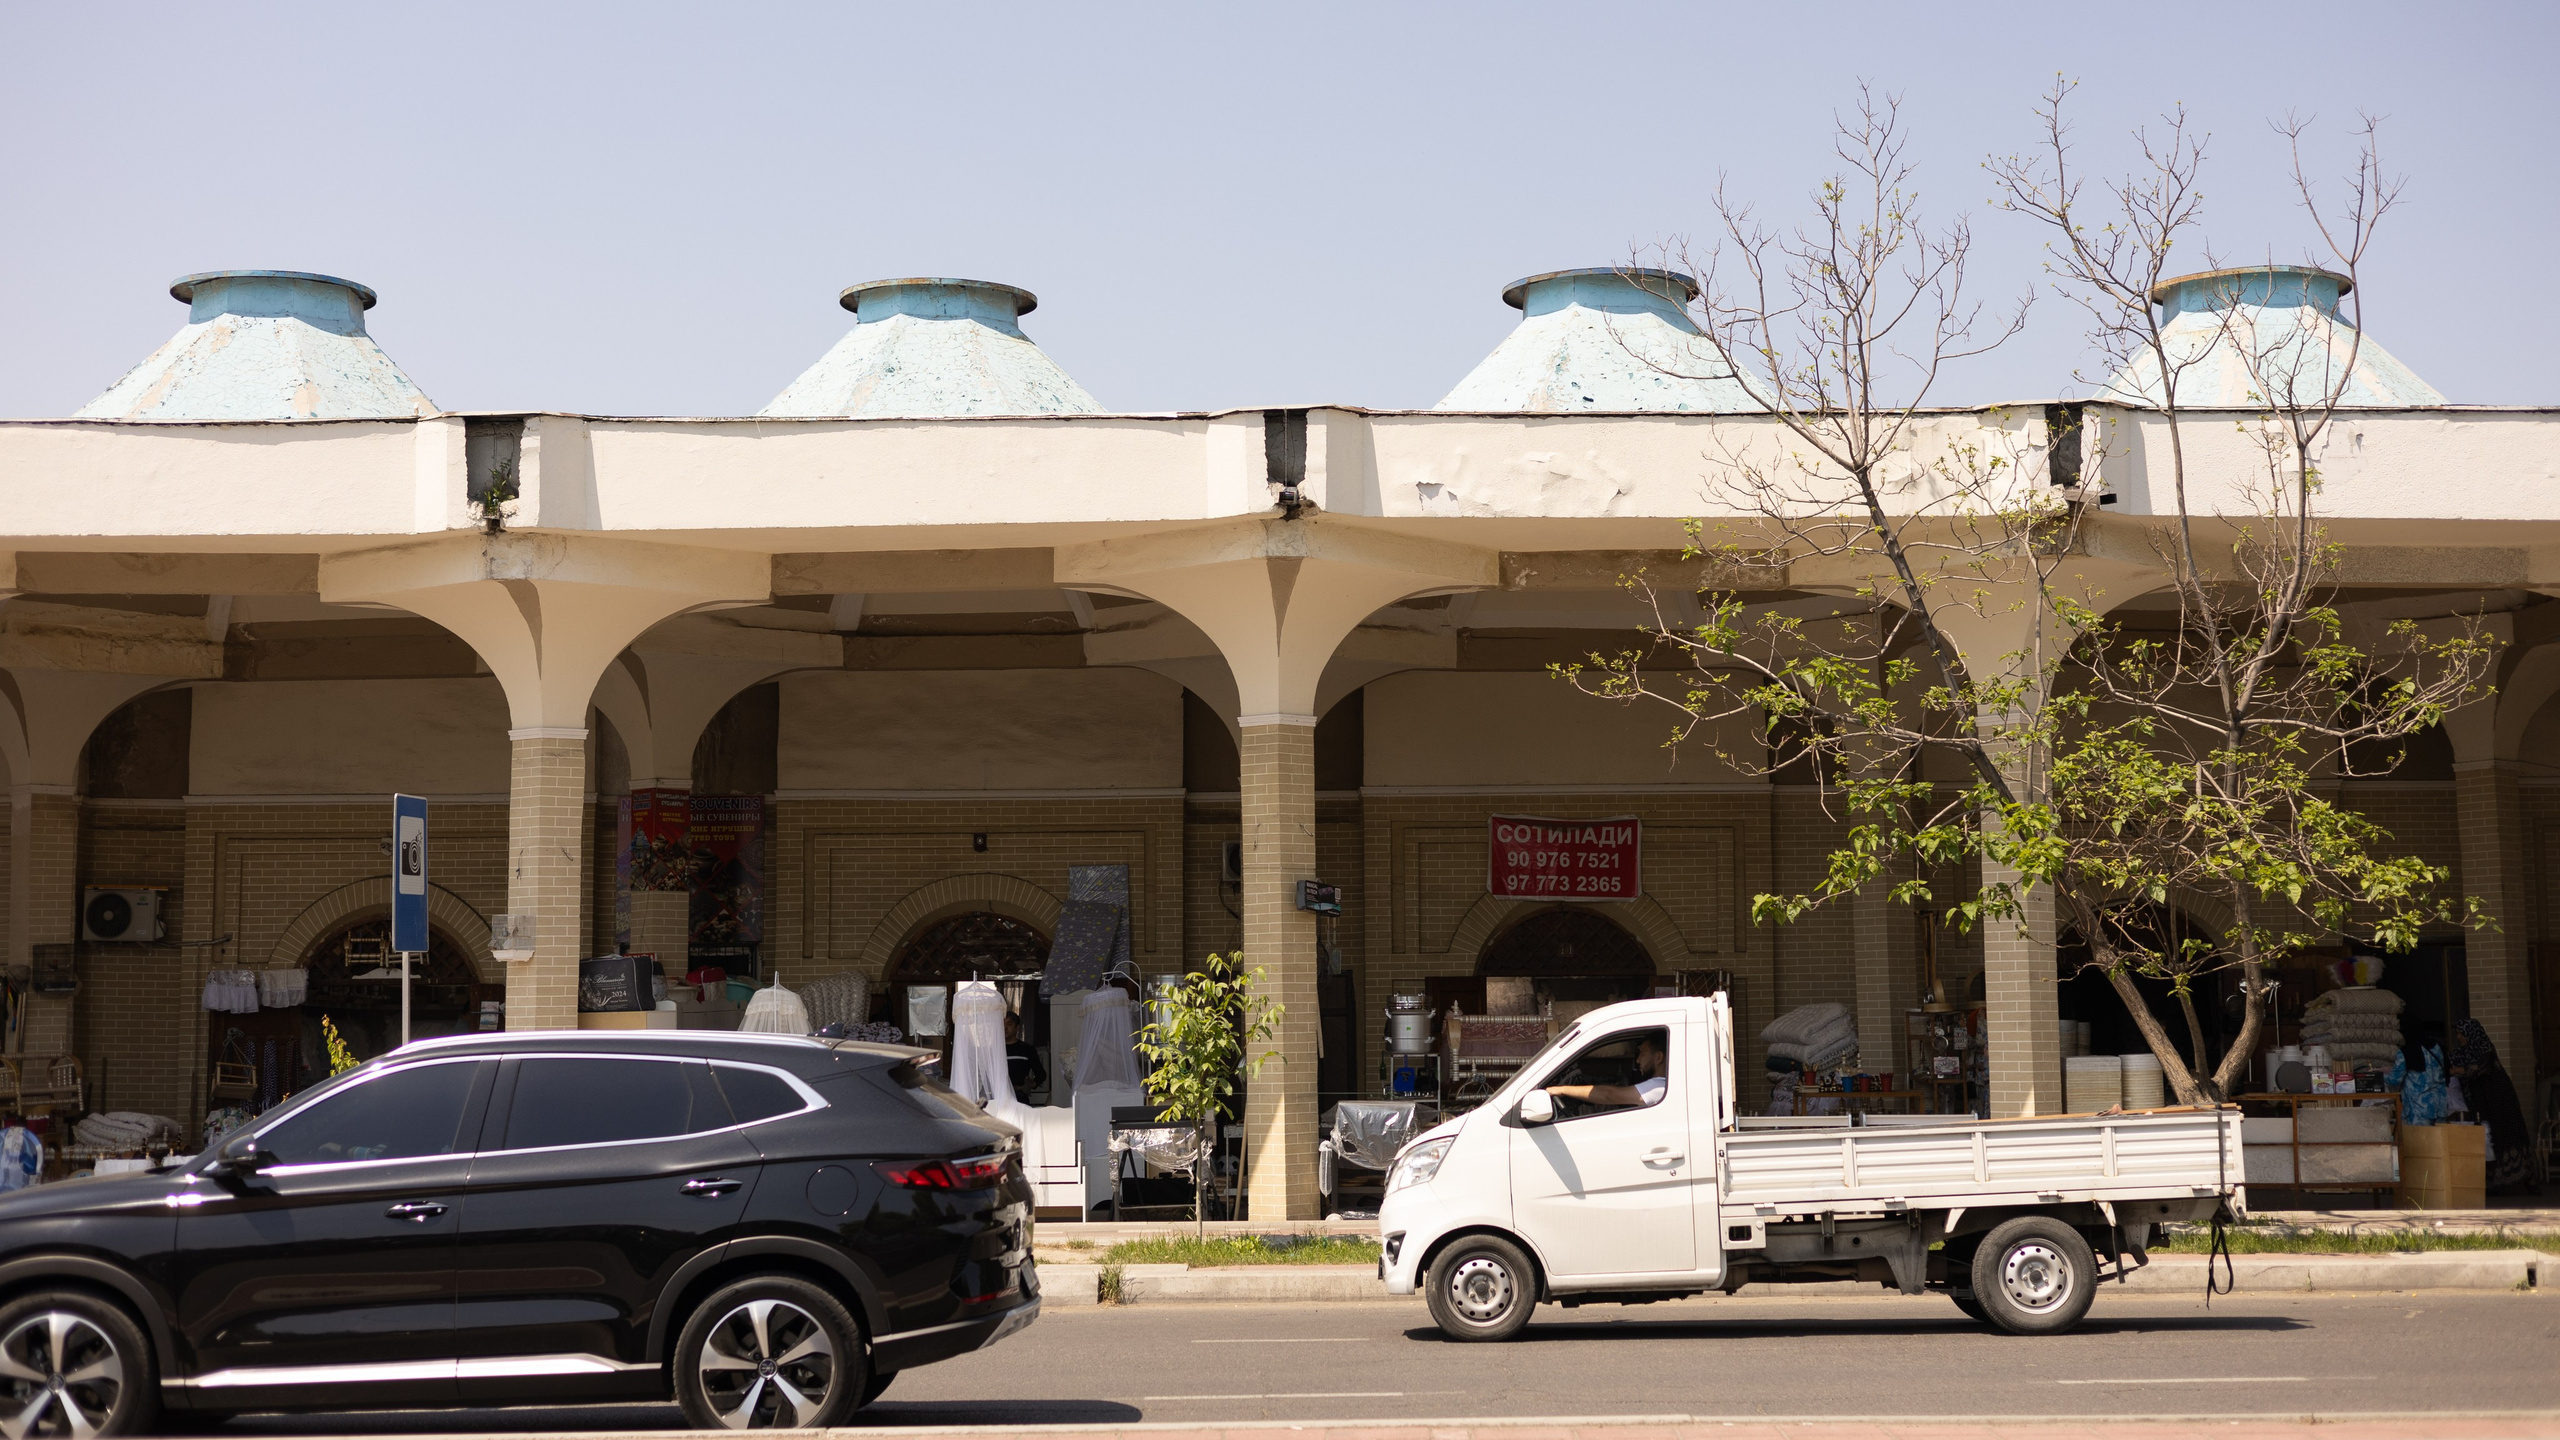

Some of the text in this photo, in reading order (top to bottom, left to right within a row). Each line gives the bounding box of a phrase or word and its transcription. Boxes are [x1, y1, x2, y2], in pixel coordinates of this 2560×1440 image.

[690, 797, 761, 810] SOUVENIRS
[707, 813, 760, 821] СУВЕНИРЫ
[1496, 824, 1632, 848] СОТИЛАДИ
[1507, 851, 1619, 868] 90 976 7521
[1507, 875, 1621, 892] 97 773 2365
[612, 990, 627, 998] 2024
